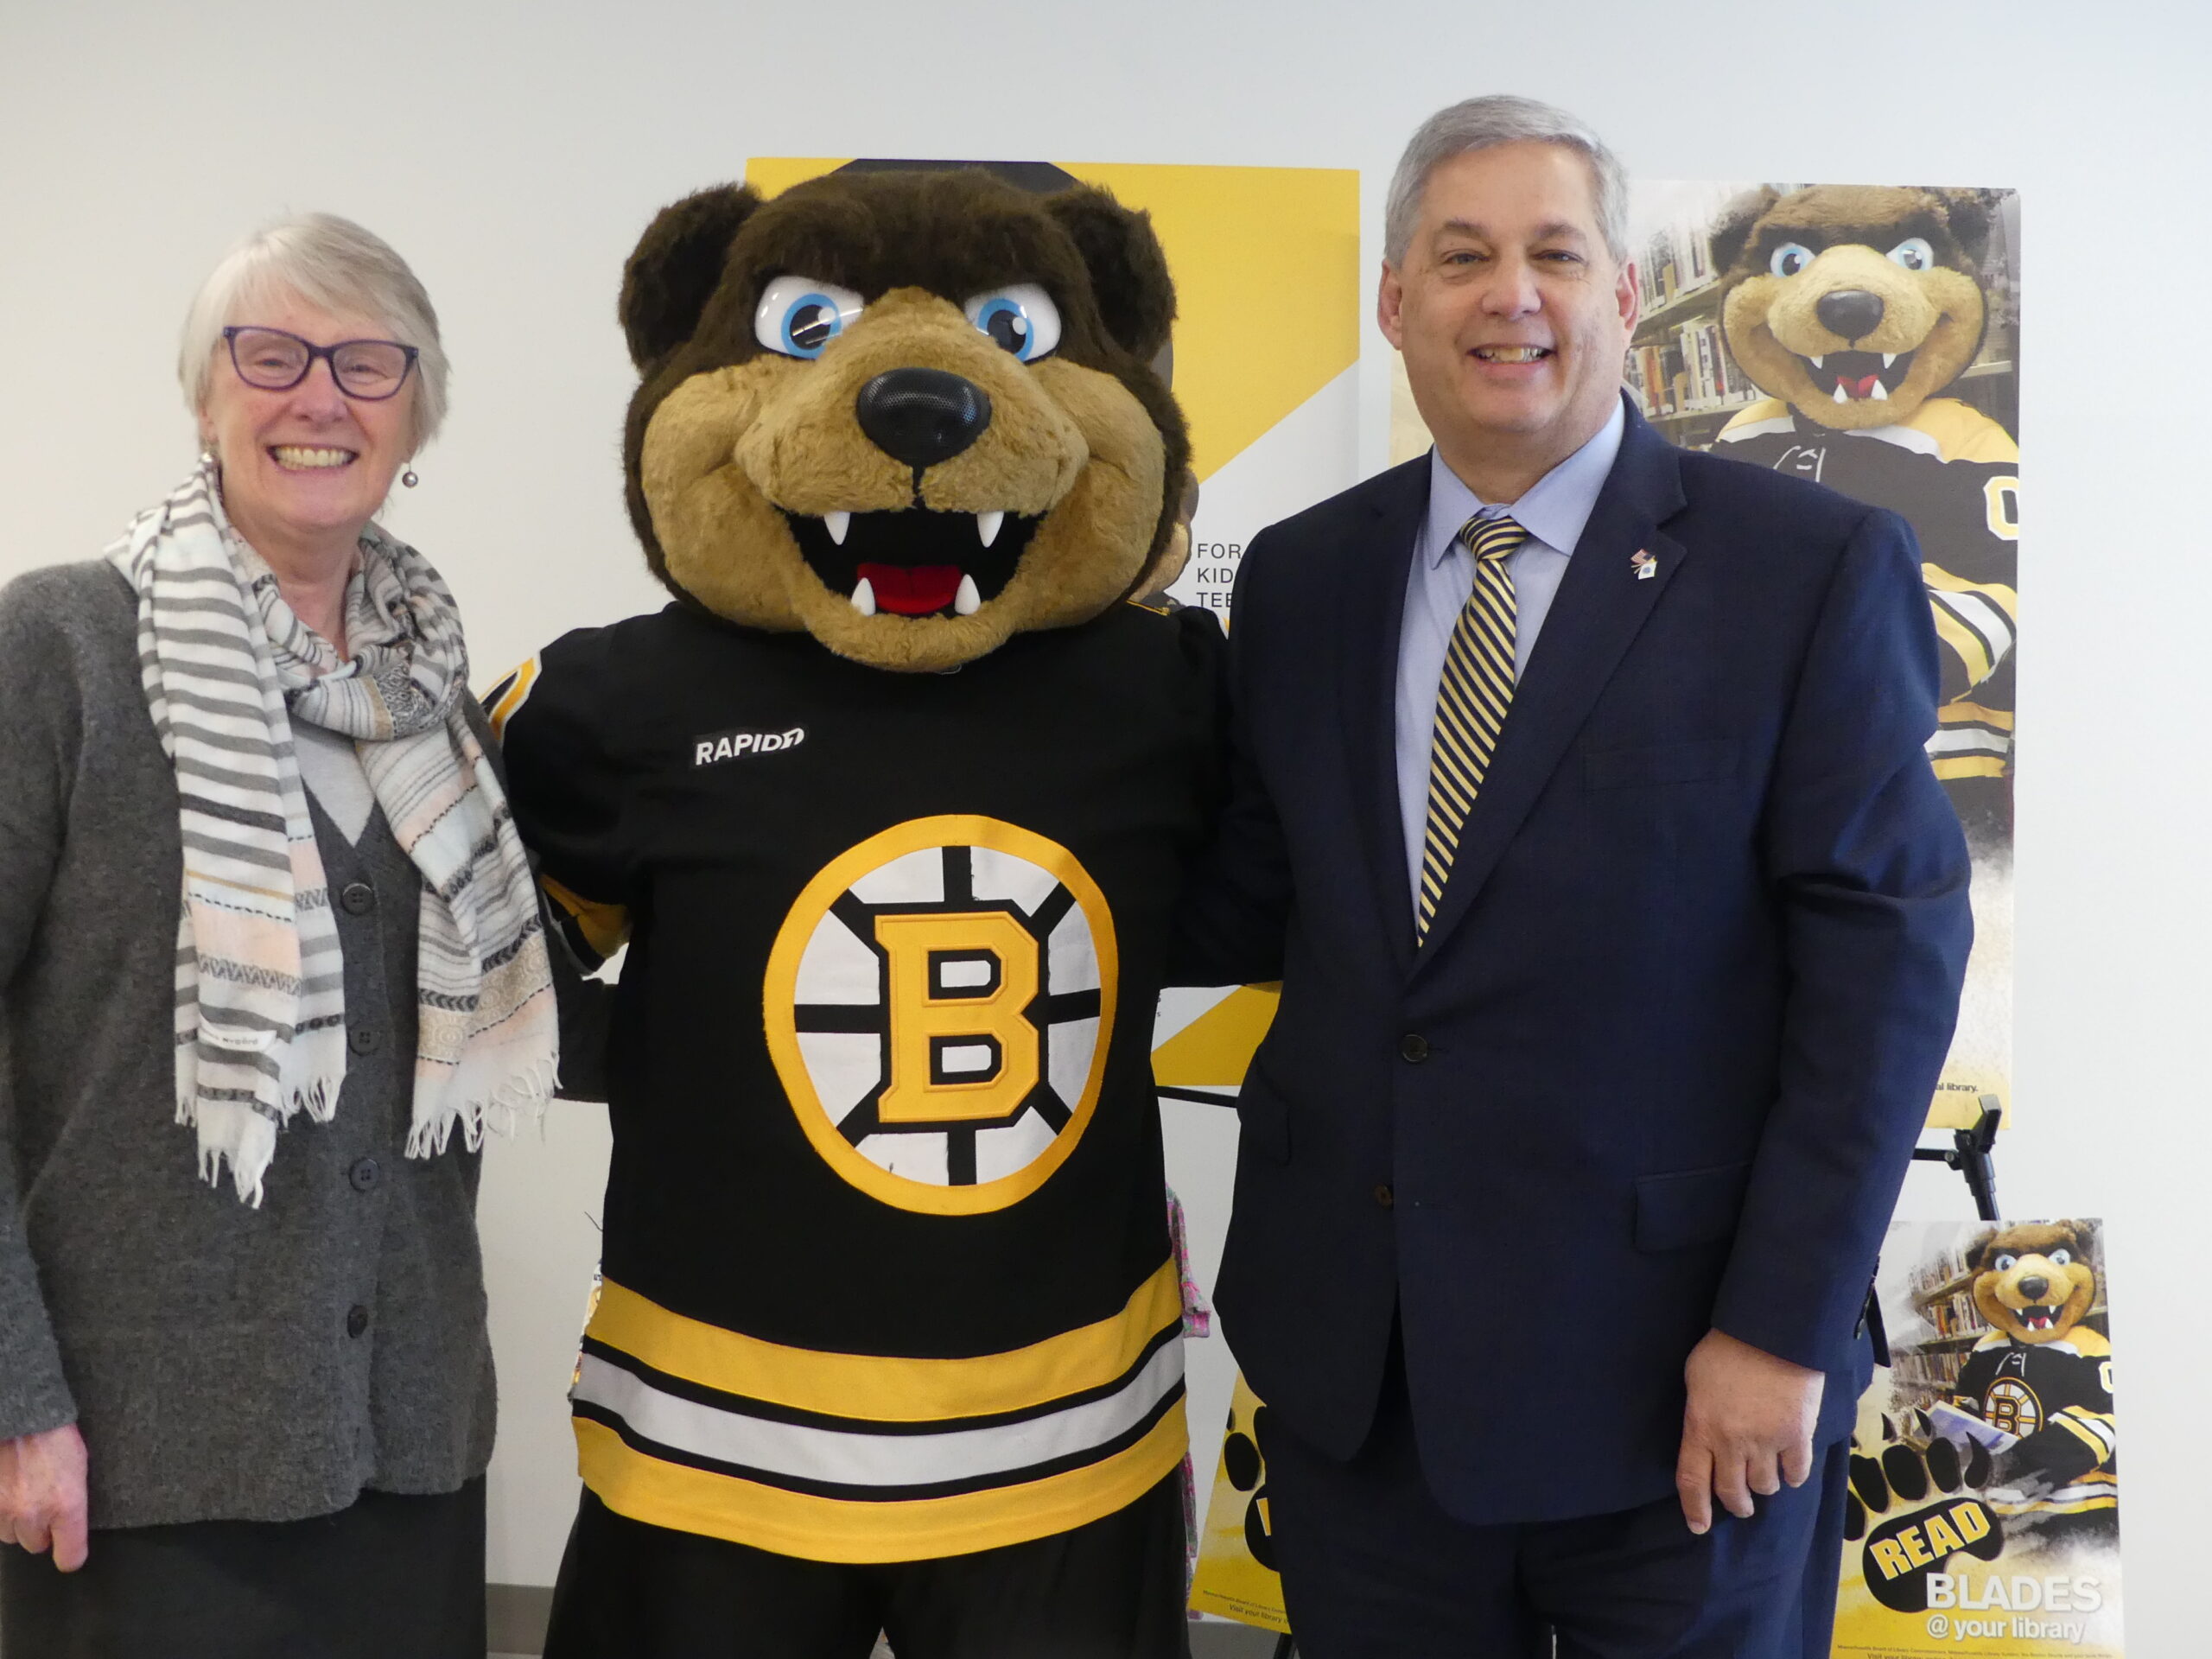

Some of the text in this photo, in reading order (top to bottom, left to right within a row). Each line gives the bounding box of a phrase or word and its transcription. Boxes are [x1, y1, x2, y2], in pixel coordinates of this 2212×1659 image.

[1198, 543, 1241, 559] FOR
[874, 911, 1039, 1123] B
[1947, 1083, 1978, 1093] library.
[1869, 1501, 1991, 1580] READ
[1926, 1572, 2102, 1613] BLADES
[1245, 1609, 1260, 1618] your
[1262, 1611, 1282, 1624] library
[1927, 1613, 2086, 1645] @ your library
